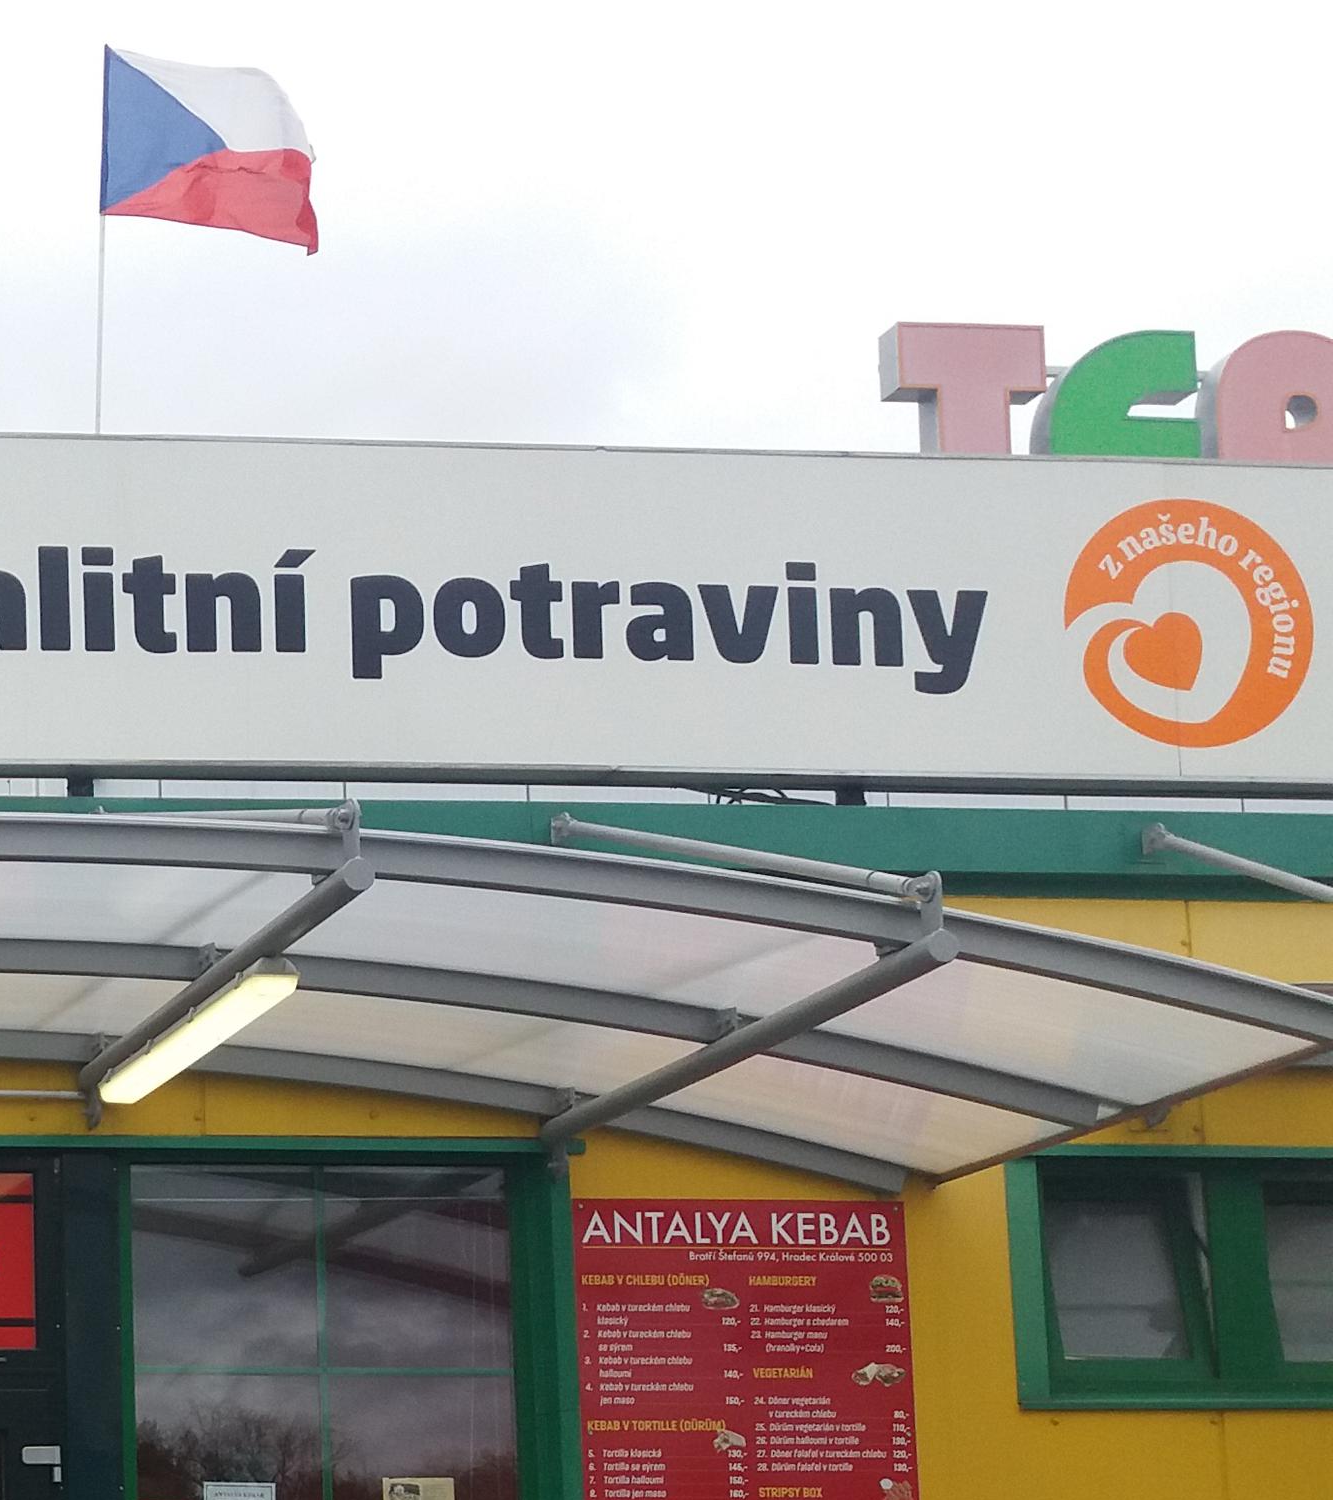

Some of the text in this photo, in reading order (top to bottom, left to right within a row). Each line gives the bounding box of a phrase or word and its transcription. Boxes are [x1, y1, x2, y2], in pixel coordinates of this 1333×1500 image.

[1098, 512, 1300, 679] z našeho regionu
[349, 561, 989, 695] potraviny
[582, 1209, 891, 1246] ANTALYA KEBAB
[688, 1250, 717, 1261] Bratří
[718, 1248, 755, 1262] Štefanů
[757, 1252, 779, 1263] 994,
[782, 1251, 817, 1262] Hradec
[858, 1253, 878, 1263] 500
[880, 1253, 894, 1263] 03
[581, 1275, 614, 1285] KEBAB
[616, 1275, 623, 1285] V
[626, 1275, 665, 1286] CHLEBU
[749, 1276, 816, 1286] HAMBURGERY
[753, 1366, 813, 1378] VEGETARIÁN
[587, 1421, 620, 1431] KEBAB
[623, 1421, 630, 1431] V
[632, 1421, 677, 1431] TORTILLE
[758, 1488, 822, 1498] STRIPSY BOX
